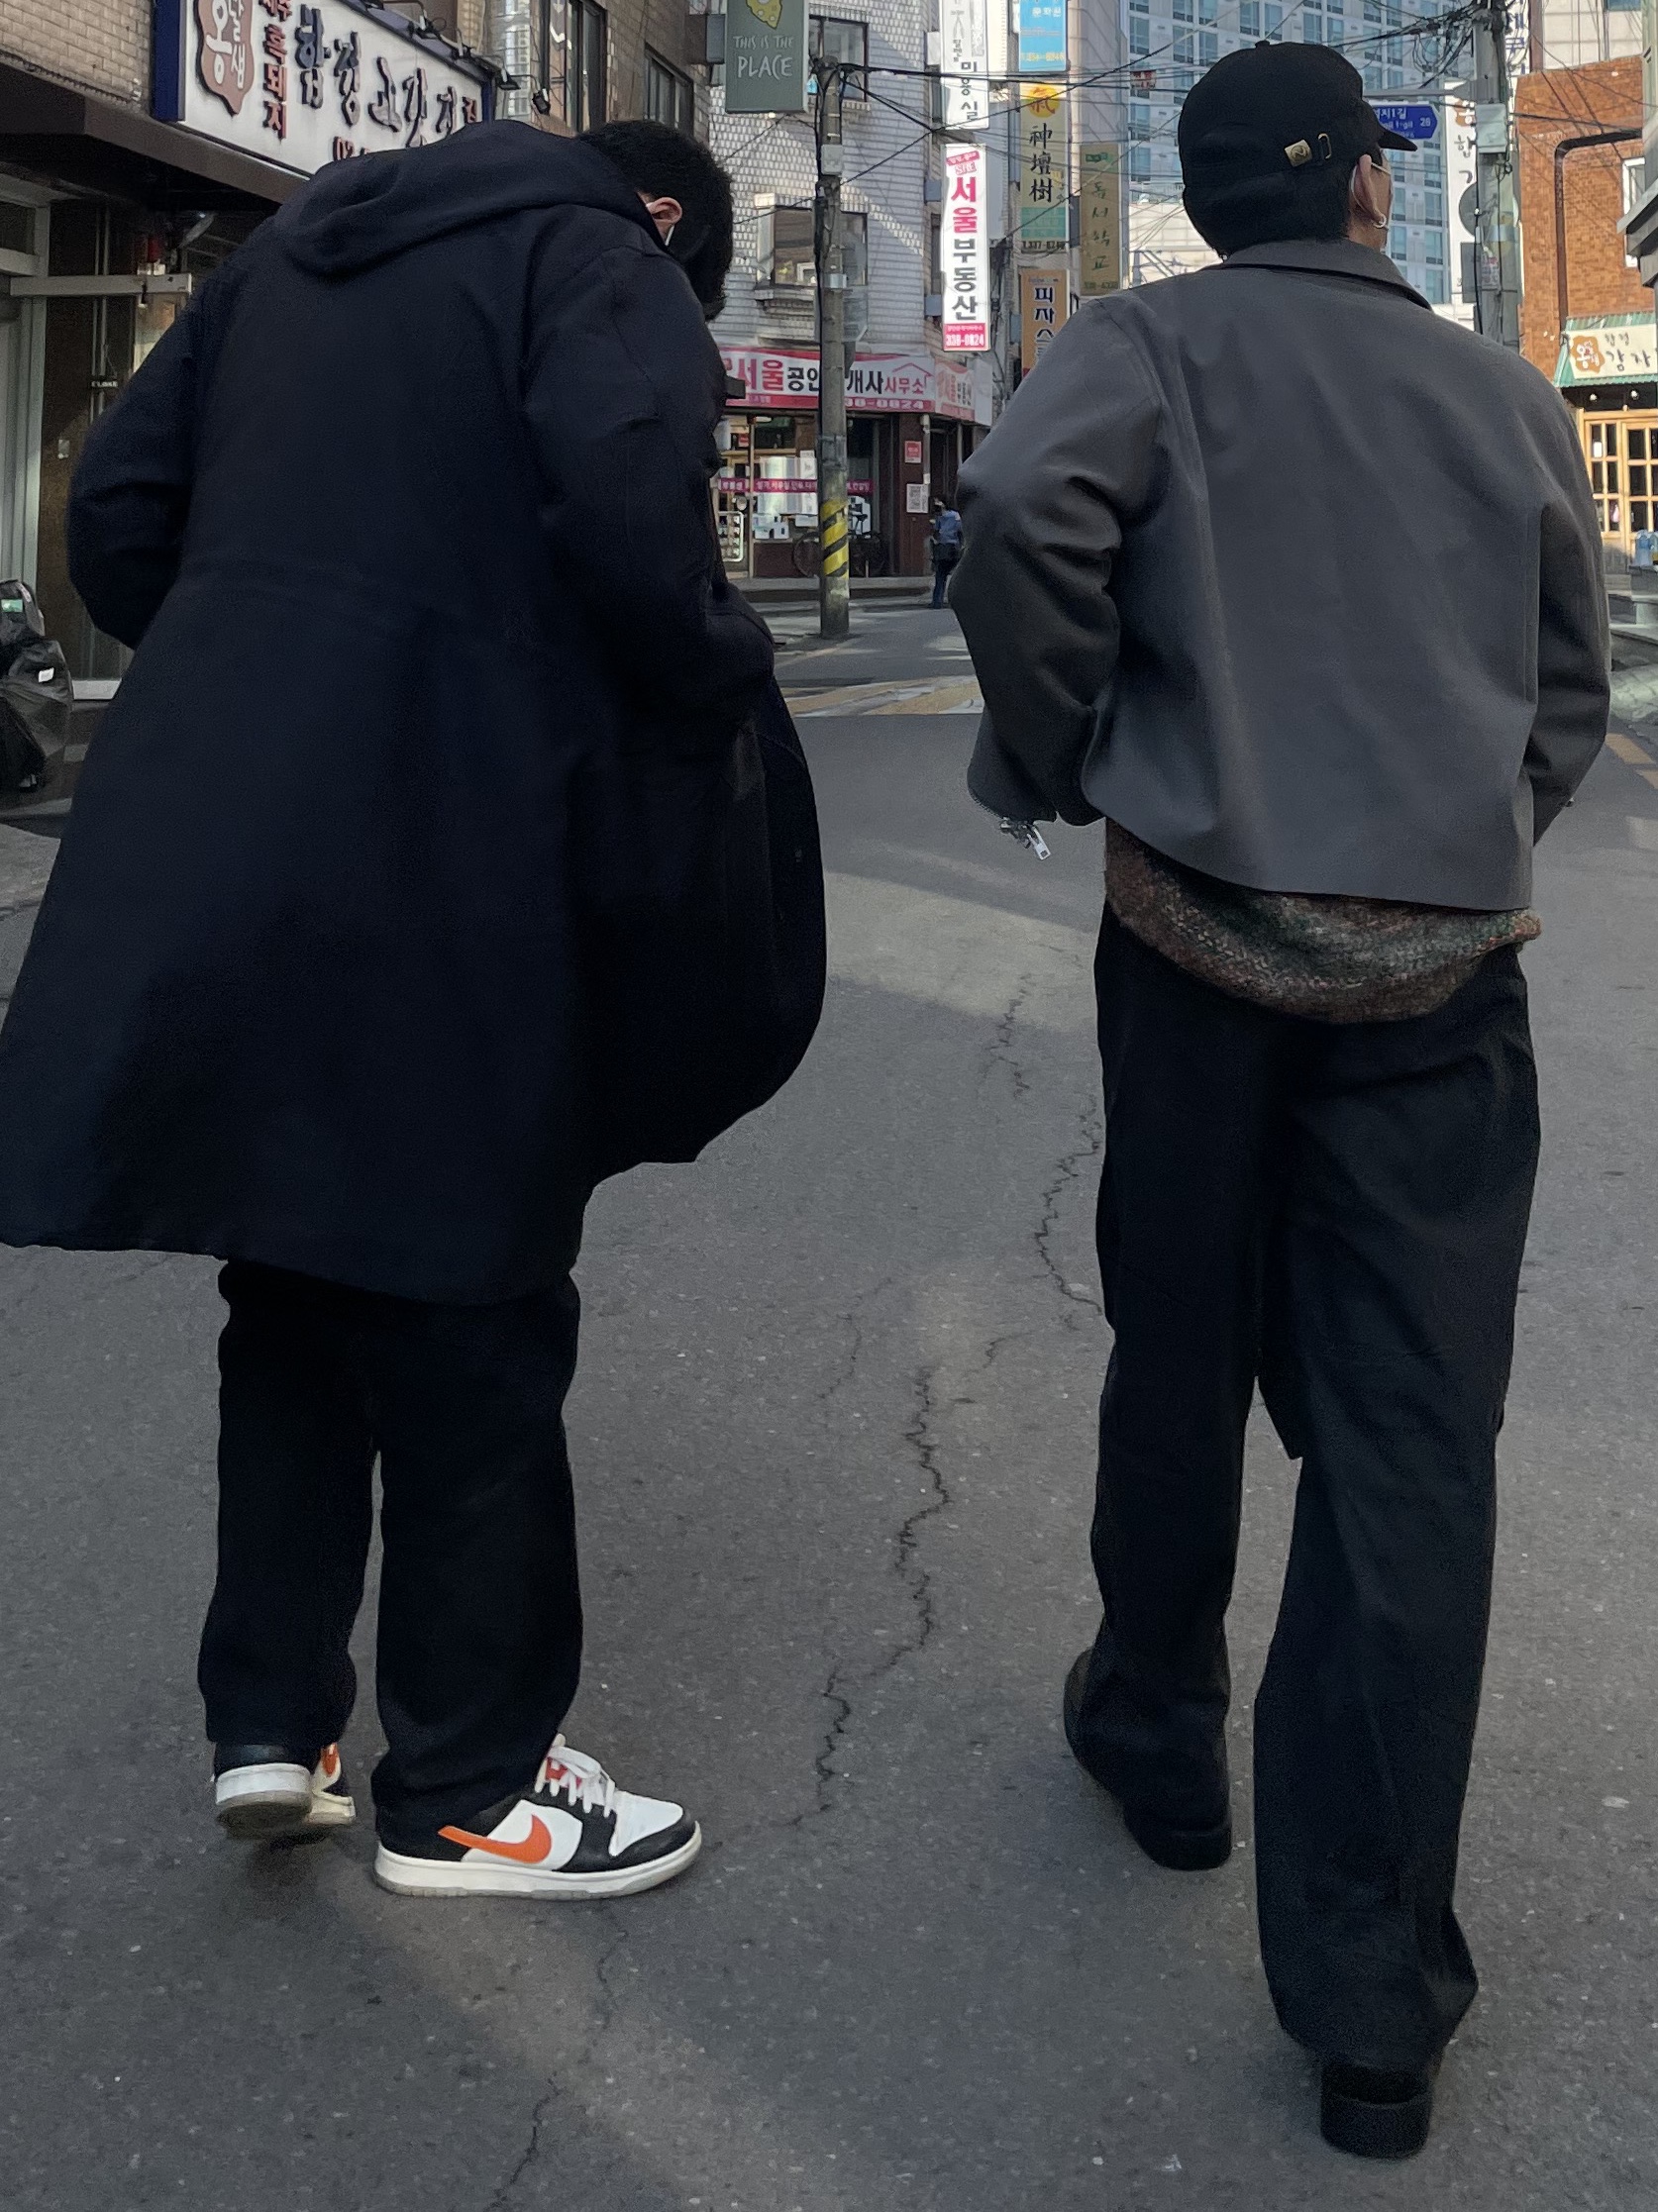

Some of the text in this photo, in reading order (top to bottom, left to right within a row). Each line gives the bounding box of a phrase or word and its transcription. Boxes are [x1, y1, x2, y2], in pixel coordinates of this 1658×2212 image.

[733, 35, 756, 50] THIS
[760, 35, 769, 50] IS
[737, 54, 793, 80] PLACE
